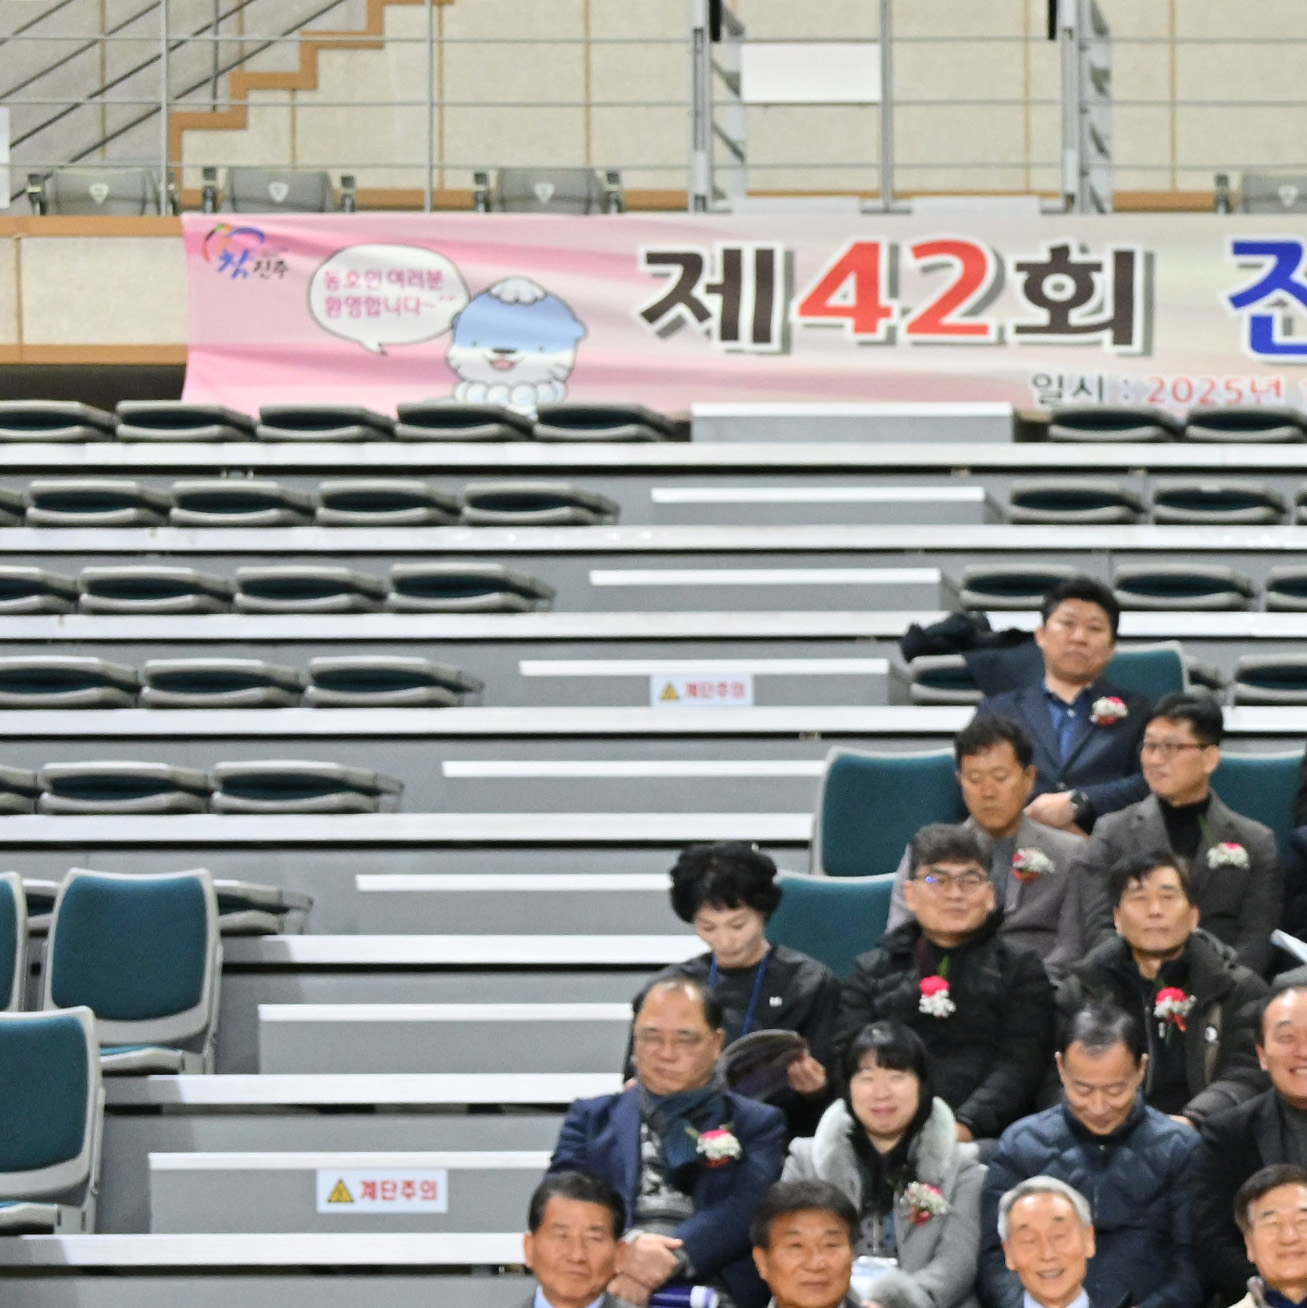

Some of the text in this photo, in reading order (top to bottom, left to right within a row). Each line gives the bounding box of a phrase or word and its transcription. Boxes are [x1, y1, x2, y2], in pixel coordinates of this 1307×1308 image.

[640, 238, 1138, 348] 제42회
[1031, 372, 1104, 405] 일시
[1147, 375, 1283, 405] 2025년
[360, 1179, 438, 1201] 계단주의
